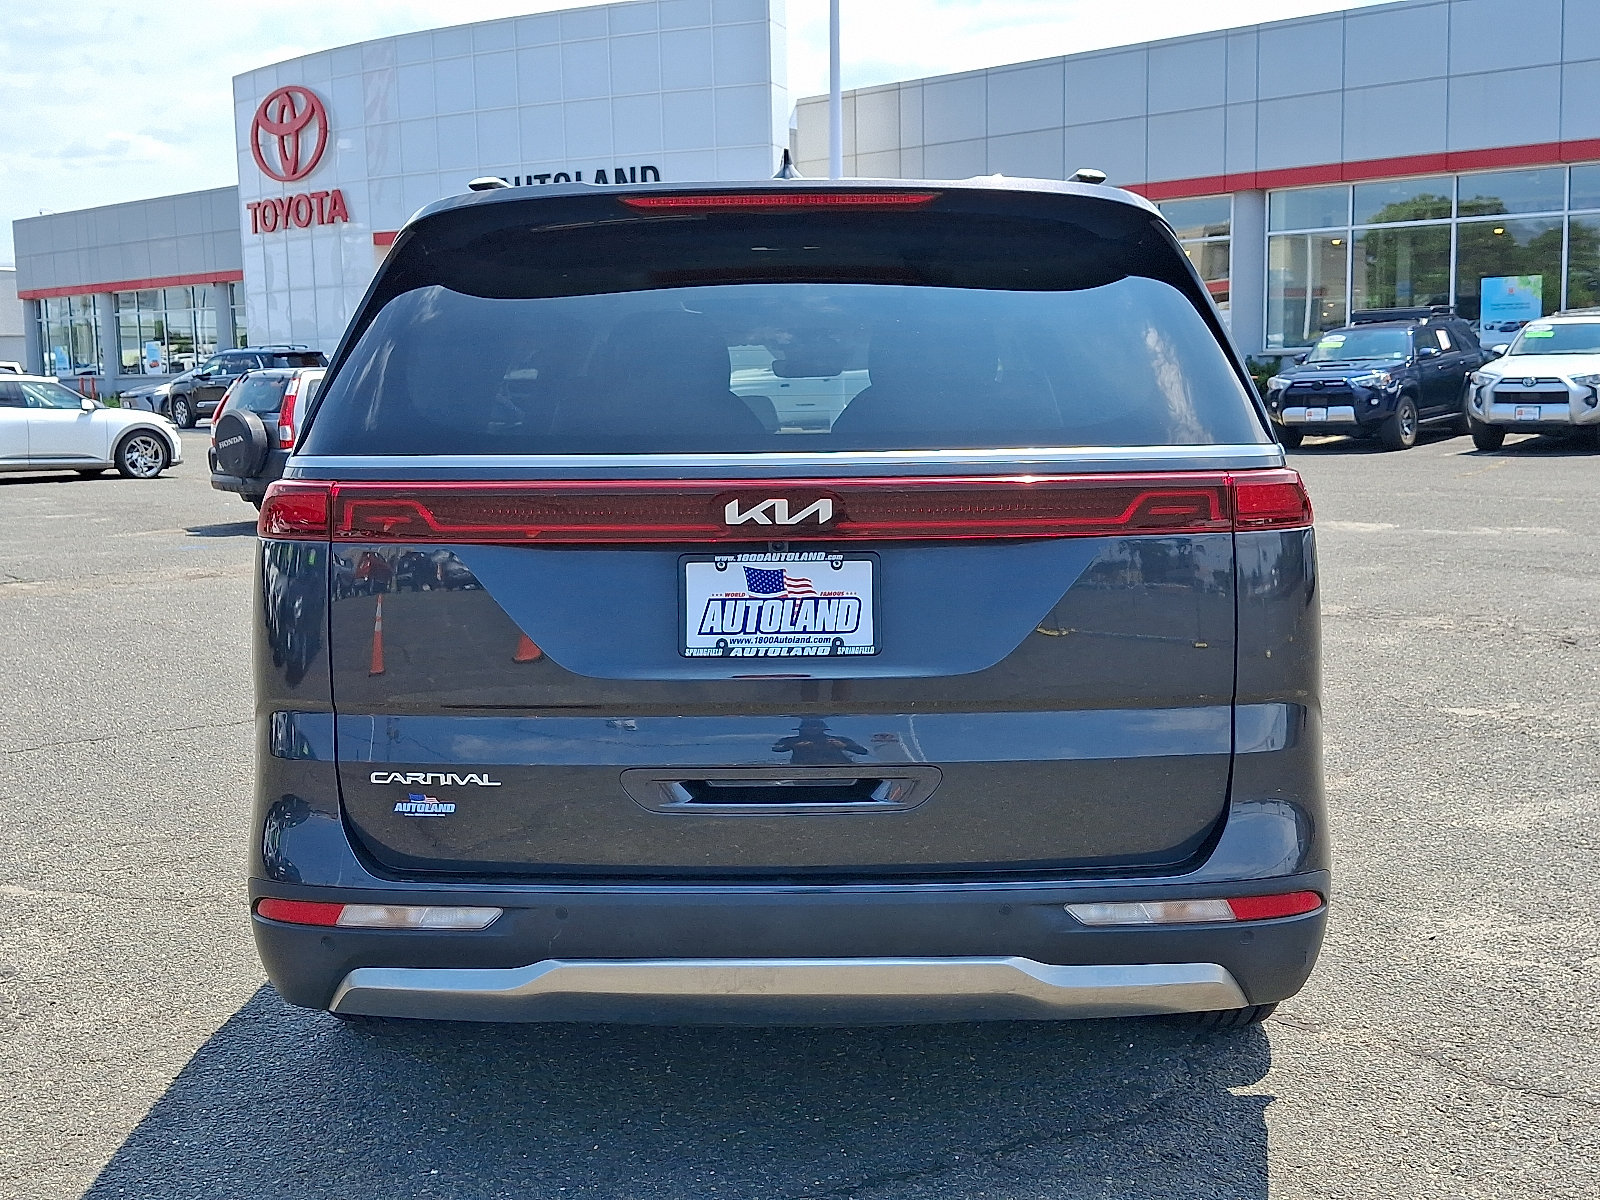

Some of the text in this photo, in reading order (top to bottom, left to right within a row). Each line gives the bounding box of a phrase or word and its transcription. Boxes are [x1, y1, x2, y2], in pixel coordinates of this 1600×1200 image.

[499, 165, 661, 186] TAND
[246, 189, 349, 235] TOYOTA
[218, 435, 244, 450] HONDA
[724, 498, 833, 525] KIA
[714, 551, 844, 562] www.1800AUTOLAND.com
[698, 598, 861, 635] AUTOLAND
[729, 636, 832, 645] www.1800Autoland.com
[685, 646, 875, 656] SPRINGFIELD AUTOLAND SPRINGFIELD
[370, 771, 502, 787] CARNIVAL
[394, 802, 456, 813] AUTOLAND
